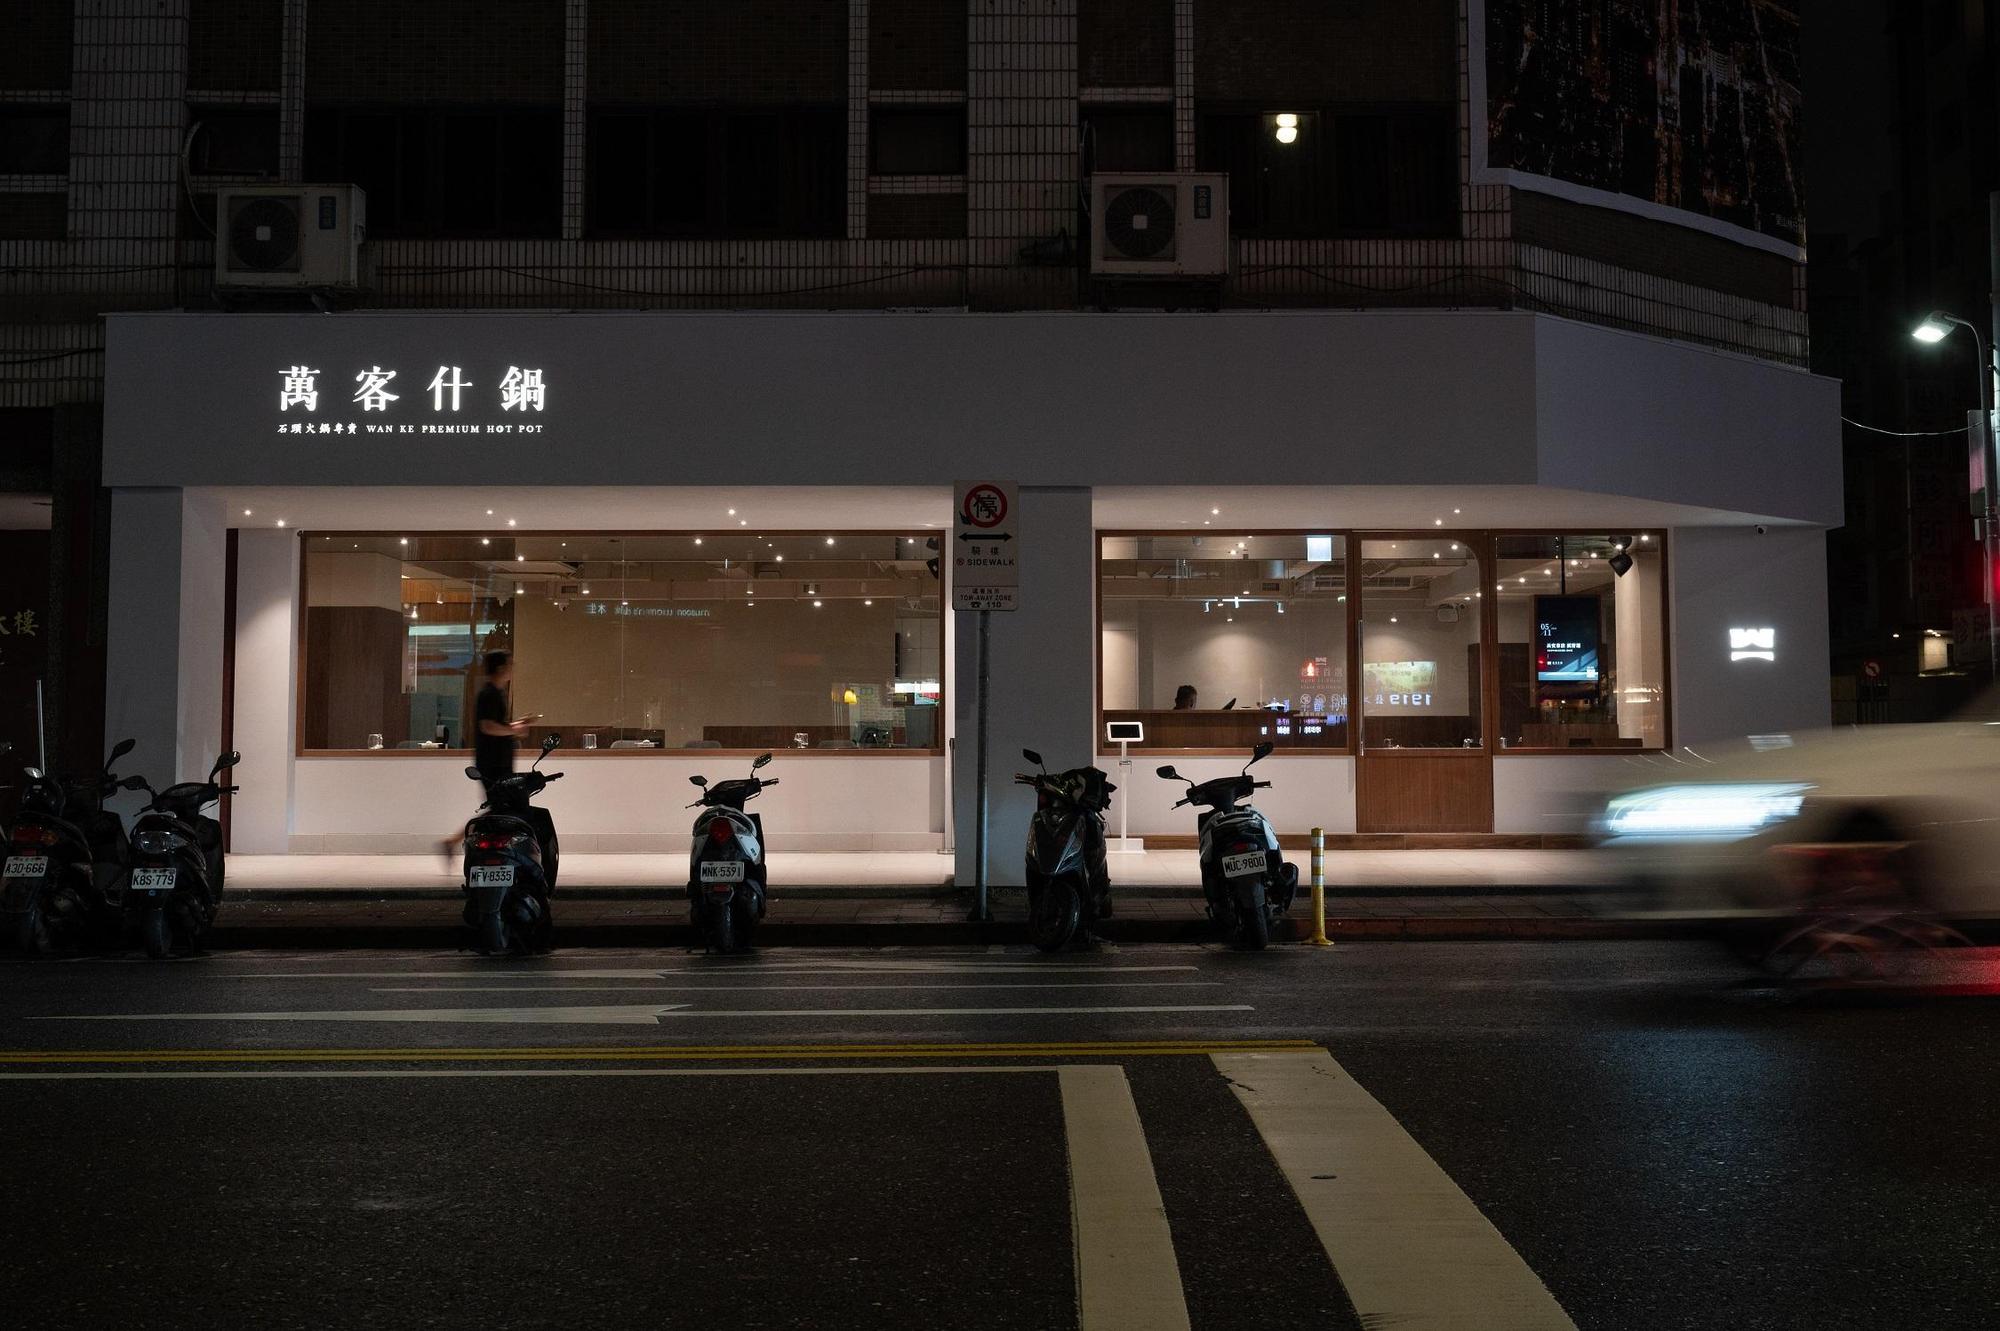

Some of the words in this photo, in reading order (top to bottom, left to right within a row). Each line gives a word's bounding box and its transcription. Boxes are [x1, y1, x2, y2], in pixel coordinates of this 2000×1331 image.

[278, 365, 546, 411] 萬客什鍋
[366, 425, 393, 433] WAN
[400, 425, 415, 433] KE
[422, 425, 480, 433] PREMIUM
[487, 425, 513, 433] HOT
[519, 425, 543, 433] POT
[973, 495, 997, 518] 停
[967, 558, 1015, 566] SIDEWALK
